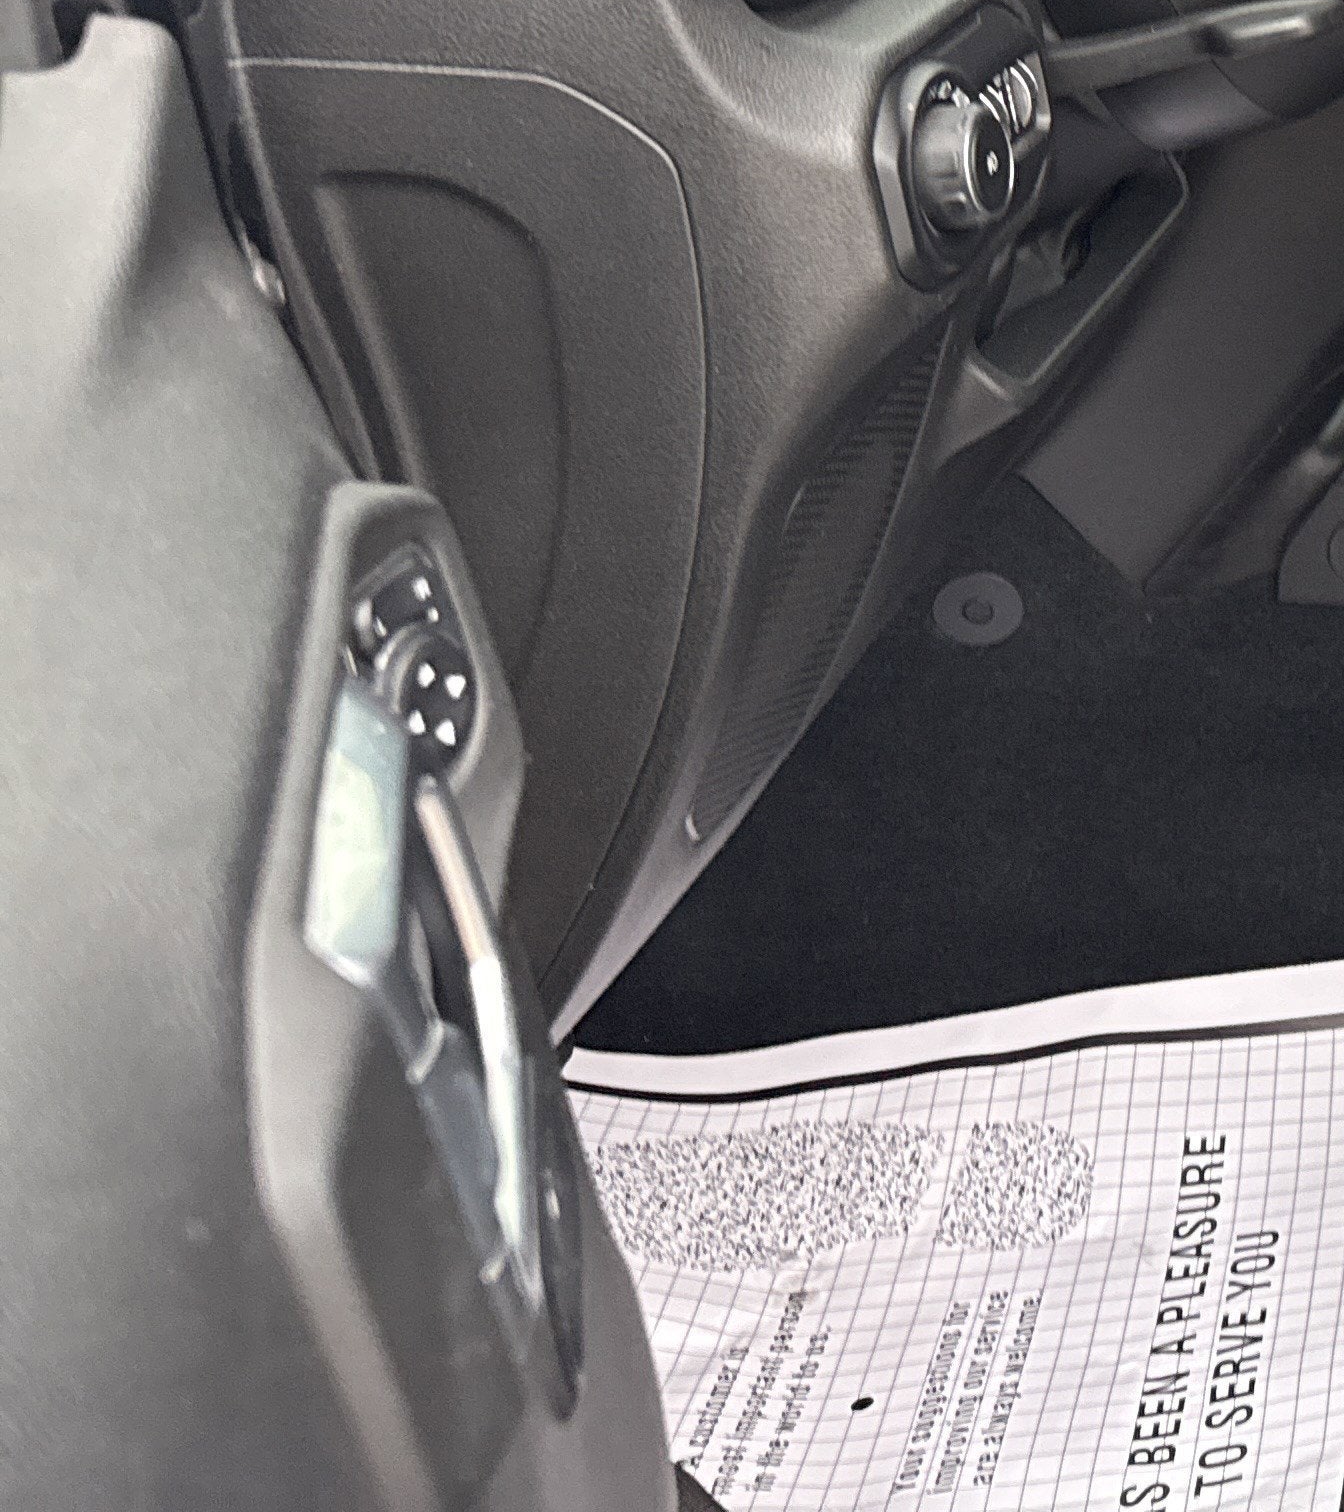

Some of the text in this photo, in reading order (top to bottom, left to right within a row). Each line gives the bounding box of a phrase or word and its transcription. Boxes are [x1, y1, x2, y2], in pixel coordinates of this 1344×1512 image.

[1156, 1134, 1227, 1327] PLEASURE
[1150, 1333, 1197, 1355] A
[1194, 1229, 1280, 1498] TO SERVE YOU
[690, 1365, 738, 1448] customer
[726, 1354, 784, 1440] important
[775, 1384, 812, 1433] world
[890, 1302, 971, 1494] Your suggestions for
[926, 1291, 1009, 1495] improving our service
[980, 1381, 1021, 1444] always
[1128, 1369, 1190, 1466] BEEN
[712, 1445, 747, 1496] most
[973, 1452, 1000, 1486] are
